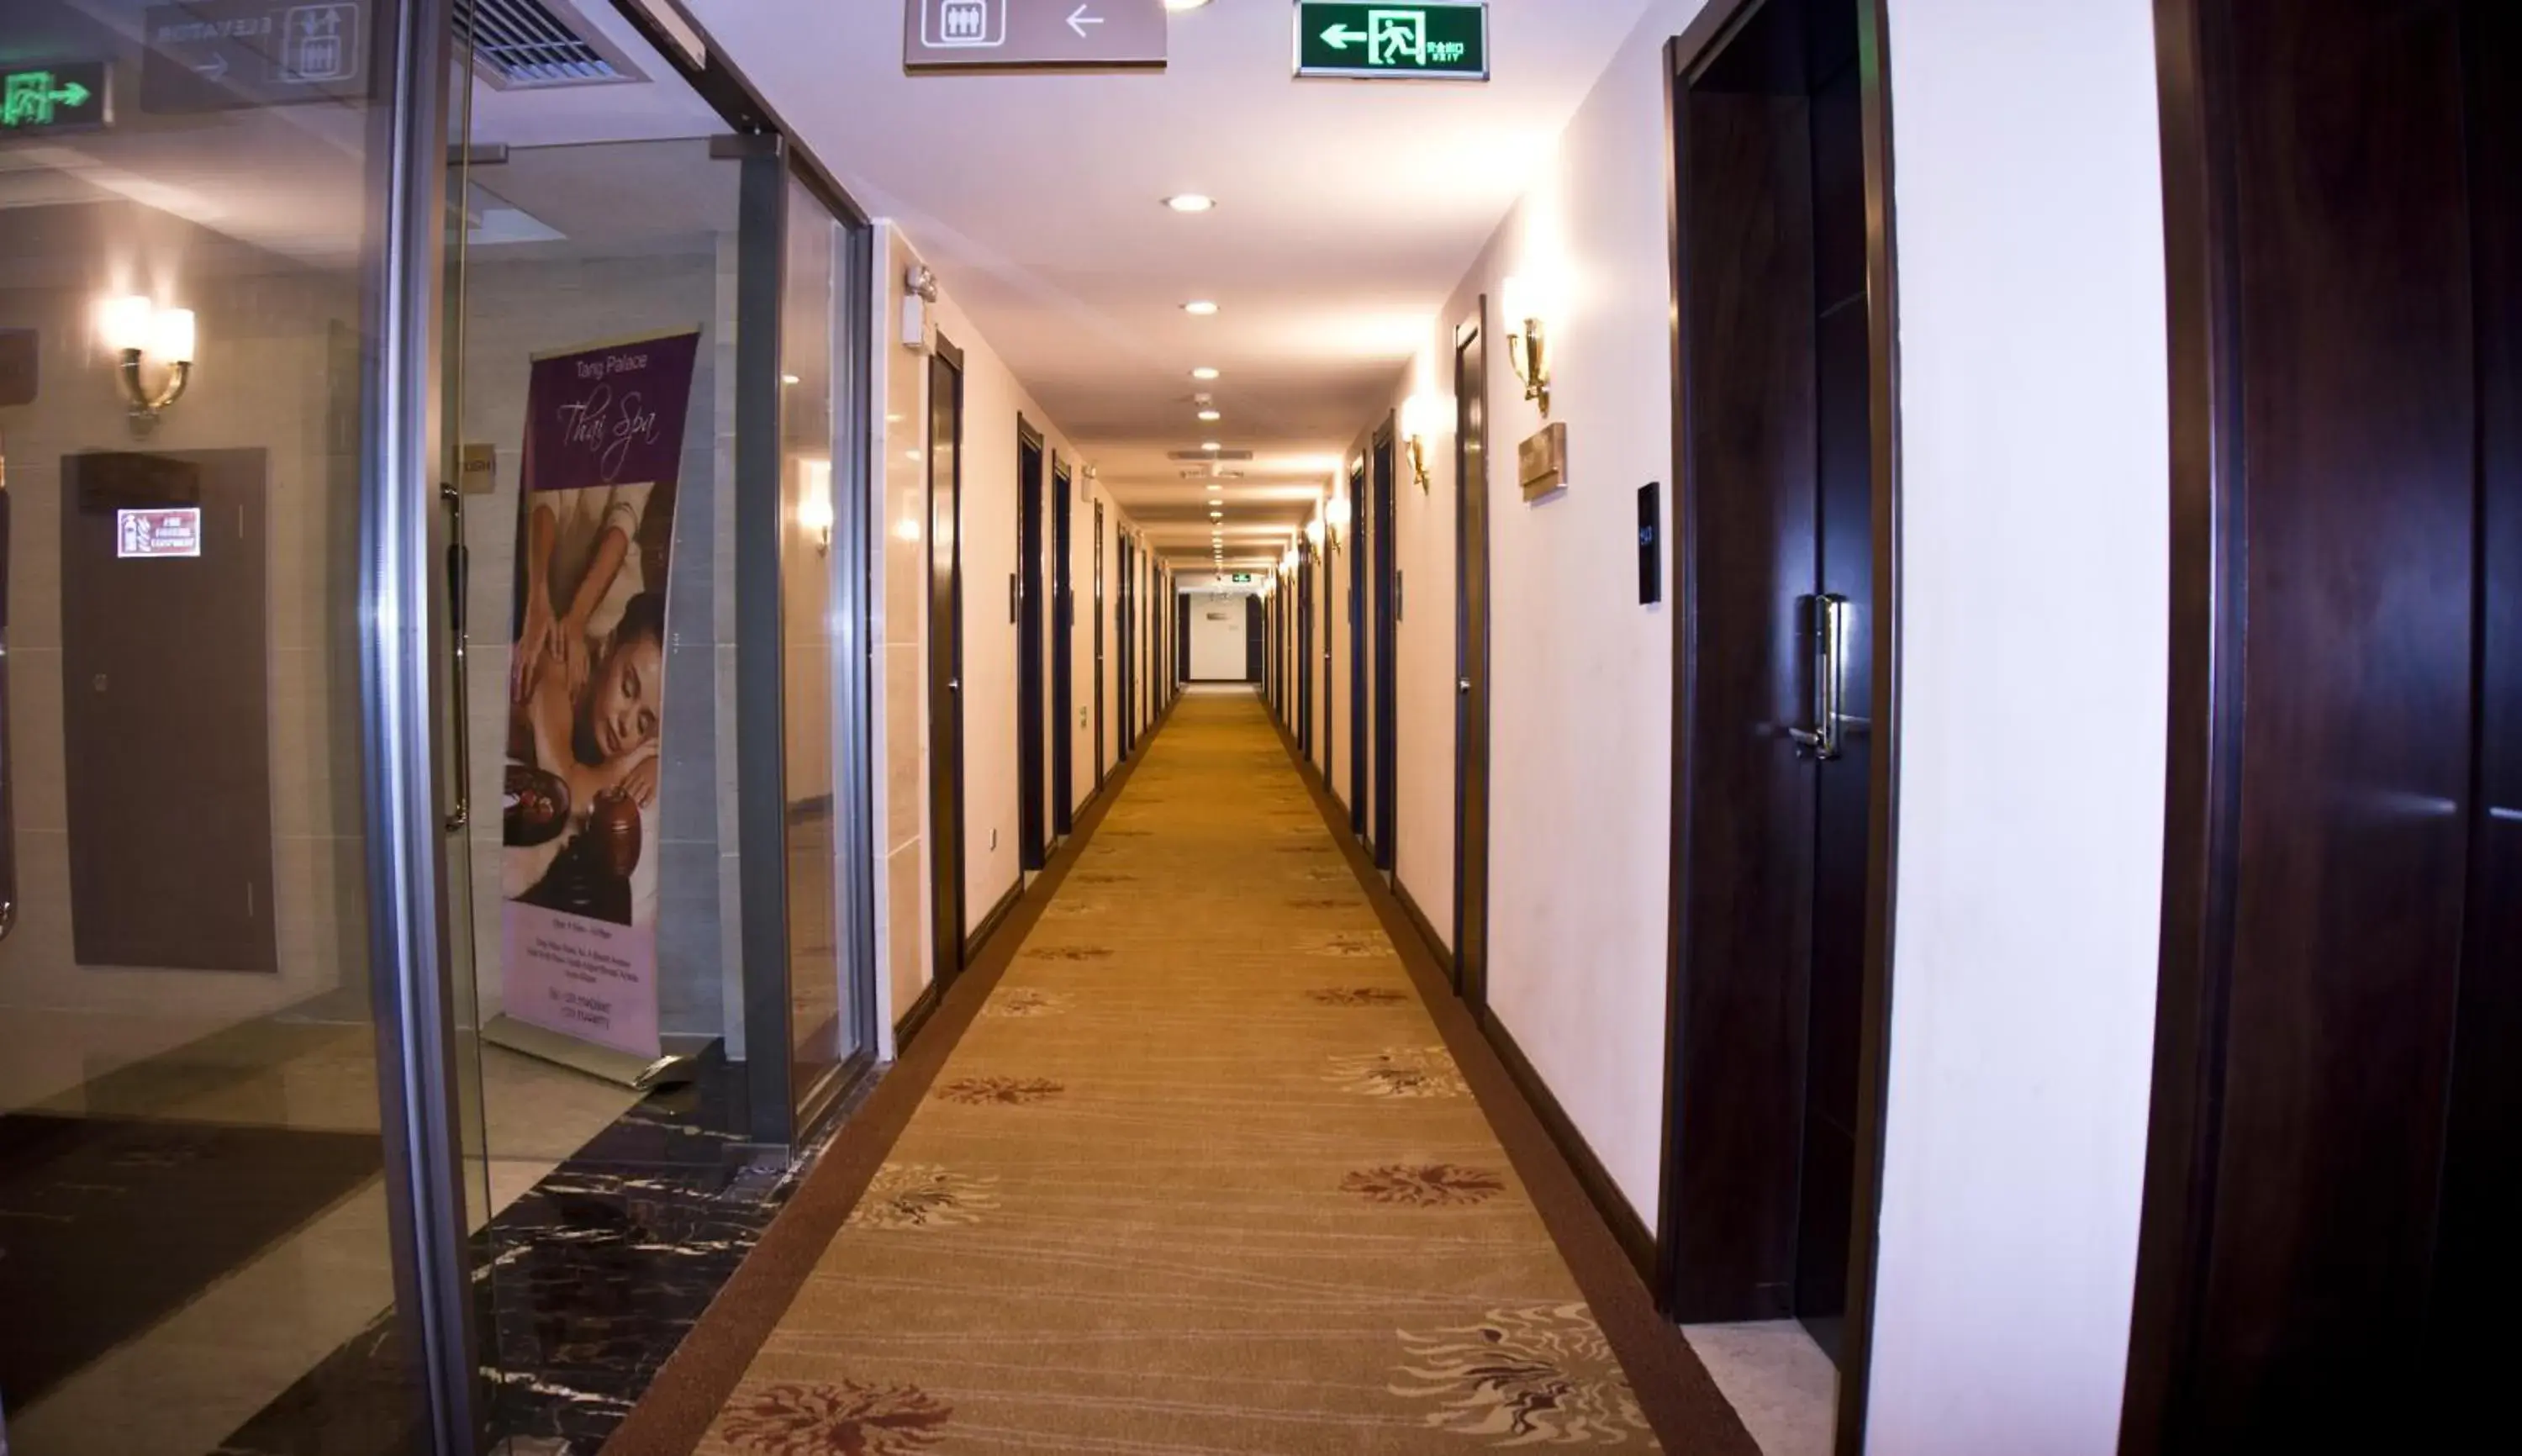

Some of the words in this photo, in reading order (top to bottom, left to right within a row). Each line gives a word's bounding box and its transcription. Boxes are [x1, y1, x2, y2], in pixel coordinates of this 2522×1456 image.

[576, 360, 604, 380] Tang
[606, 354, 649, 373] Palace
[558, 382, 611, 451] Thai
[600, 391, 661, 483] Spa
